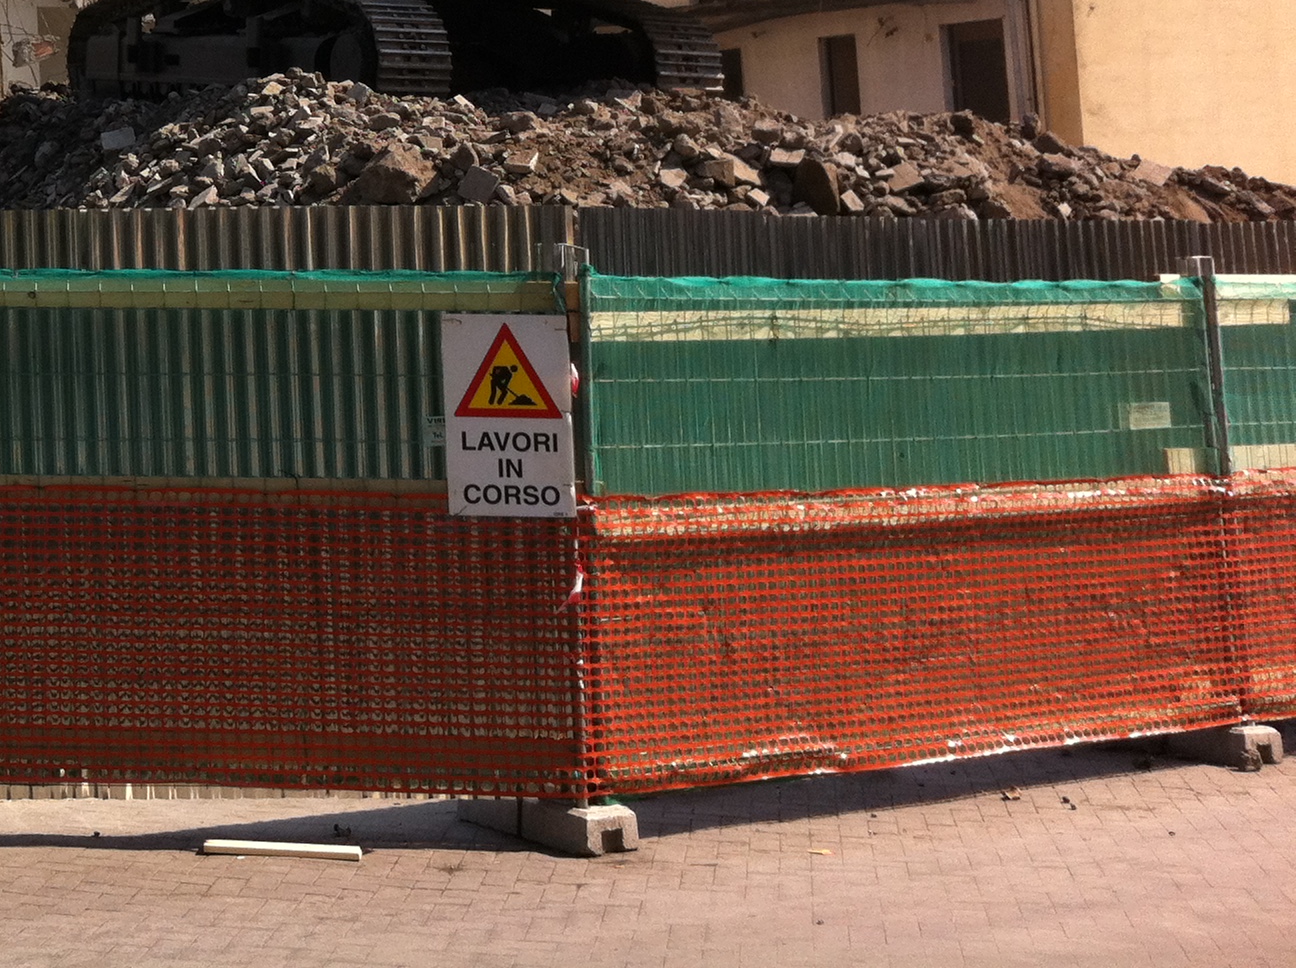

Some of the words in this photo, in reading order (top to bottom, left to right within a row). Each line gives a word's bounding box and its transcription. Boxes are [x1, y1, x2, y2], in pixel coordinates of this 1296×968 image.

[461, 431, 558, 452] LAVORI
[498, 458, 523, 478] IN
[464, 484, 560, 506] CORSO
